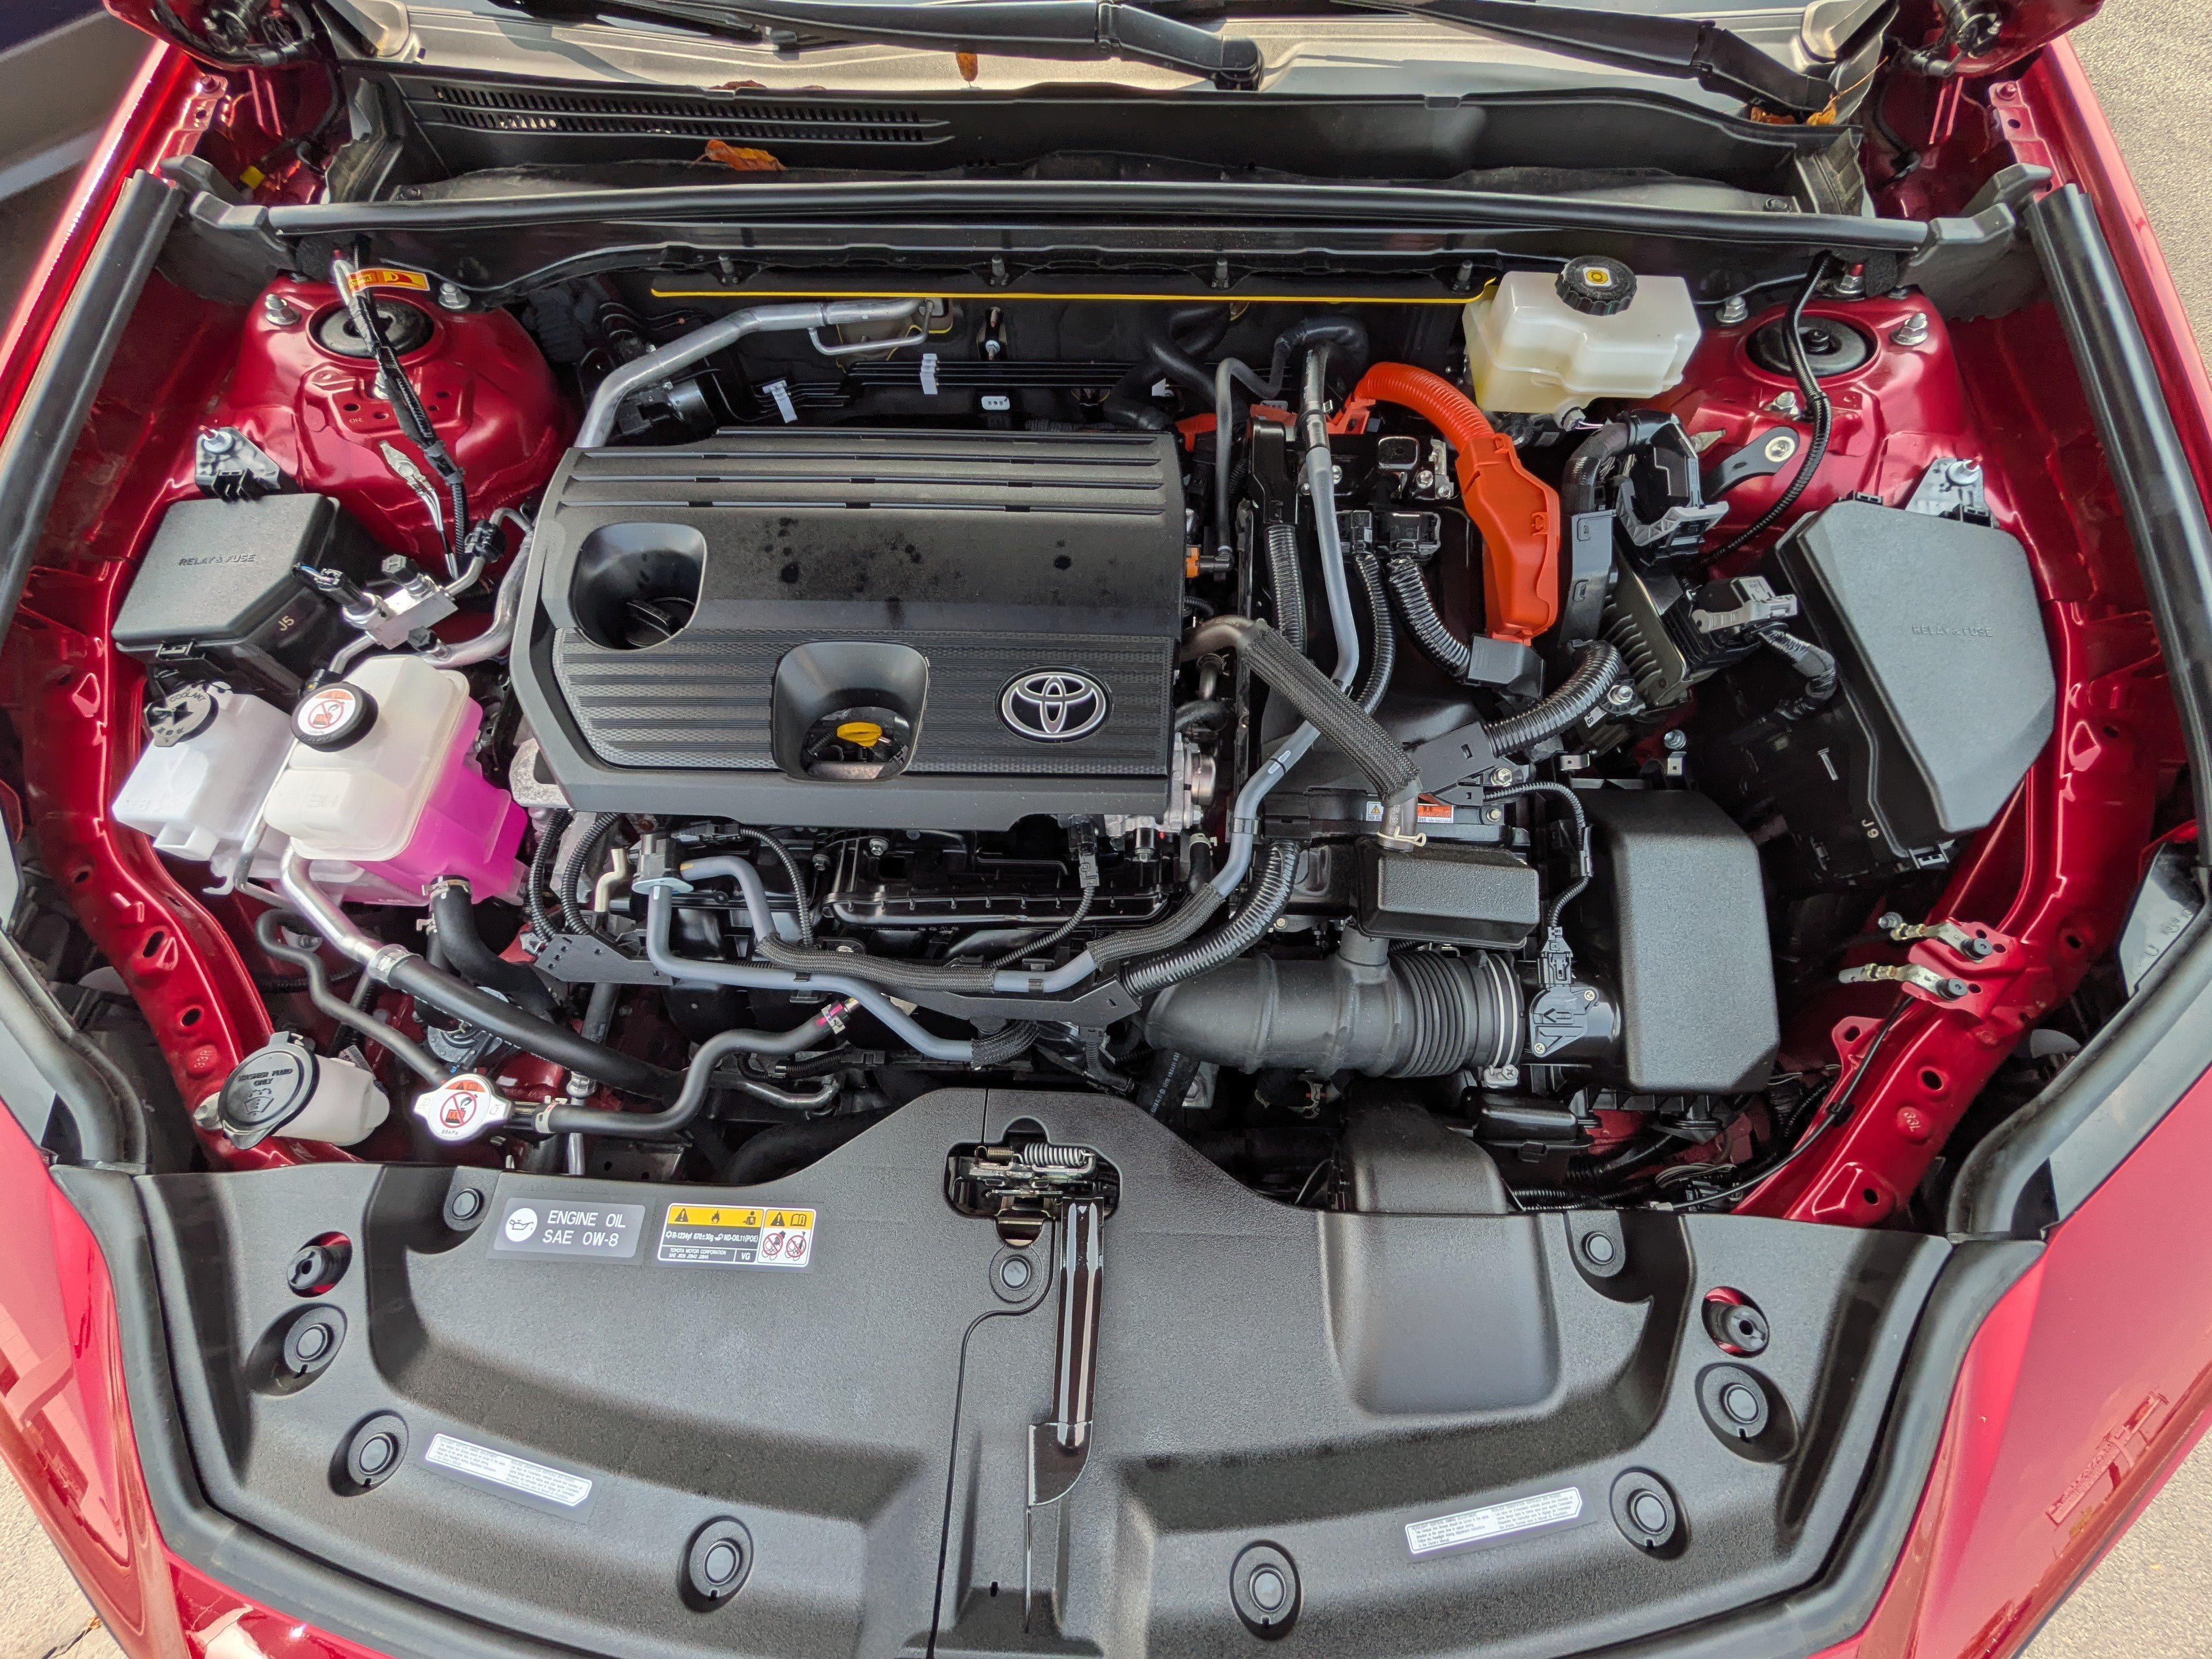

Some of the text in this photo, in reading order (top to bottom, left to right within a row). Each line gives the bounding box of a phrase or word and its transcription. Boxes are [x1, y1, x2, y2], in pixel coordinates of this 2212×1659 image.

[226, 554, 256, 563] FUSE
[278, 615, 294, 631] J5
[1911, 625, 1949, 635] RELAY
[1962, 627, 1994, 637] FUSE
[238, 1068, 293, 1081] WASHER FLUID
[253, 1077, 274, 1087] ONLY
[547, 1210, 627, 1228] ENGINE OIL
[542, 1229, 619, 1247] SAE 0W-8
[672, 1231, 693, 1241] R-1234yf
[741, 1252, 751, 1260] VG
